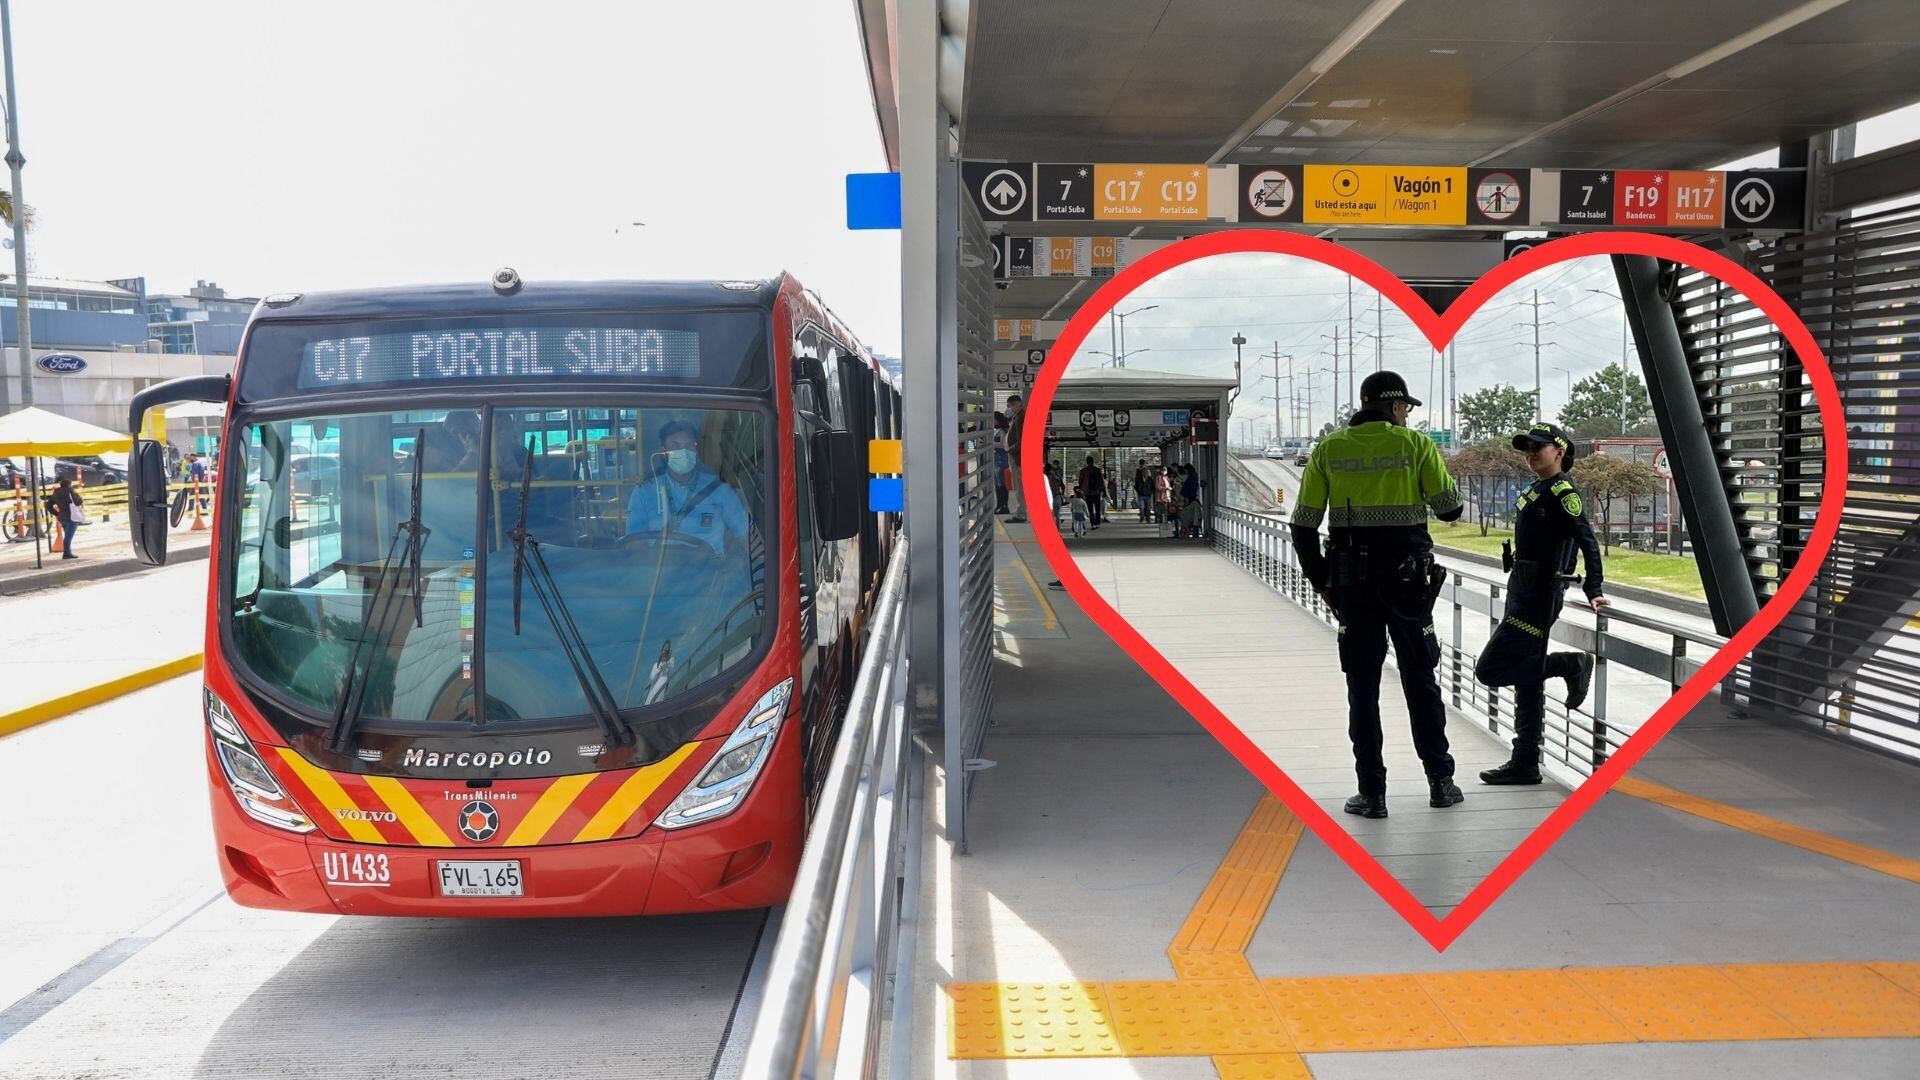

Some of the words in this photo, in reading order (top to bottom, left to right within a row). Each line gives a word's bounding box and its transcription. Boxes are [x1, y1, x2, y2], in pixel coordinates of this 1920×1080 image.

[1060, 180, 1072, 201] 7
[1105, 180, 1141, 201] C17
[1161, 180, 1198, 202] C19
[1394, 176, 1441, 197] Vagón
[1445, 177, 1452, 194] 1
[1582, 186, 1593, 206] 7
[1625, 185, 1659, 207] F19
[1677, 187, 1715, 208] H17
[1046, 205, 1067, 214] Portal
[1068, 205, 1085, 214] Suba
[1104, 206, 1124, 214] Portal
[1125, 206, 1142, 214] Suba
[1160, 206, 1181, 214] Portal
[1182, 206, 1199, 214] Suba
[1315, 200, 1338, 209] Usted
[1432, 199, 1437, 211] 1
[1567, 210, 1586, 219] Santa
[1587, 210, 1607, 219] Isabel
[1626, 212, 1656, 220] Banderas
[1675, 212, 1695, 221] Portal
[1696, 213, 1714, 221] Usme
[1018, 248, 1025, 260] 7
[1052, 248, 1072, 260] C17
[1093, 246, 1113, 257] C19
[313, 336, 371, 382] C17
[411, 331, 554, 377] PORTAL
[565, 329, 664, 373] SUBA
[50, 357, 79, 369] Ford
[403, 748, 552, 769] Marcopolo
[444, 790, 518, 801] TransMilenio
[335, 809, 398, 823] VOLVO
[323, 852, 391, 882] U1433
